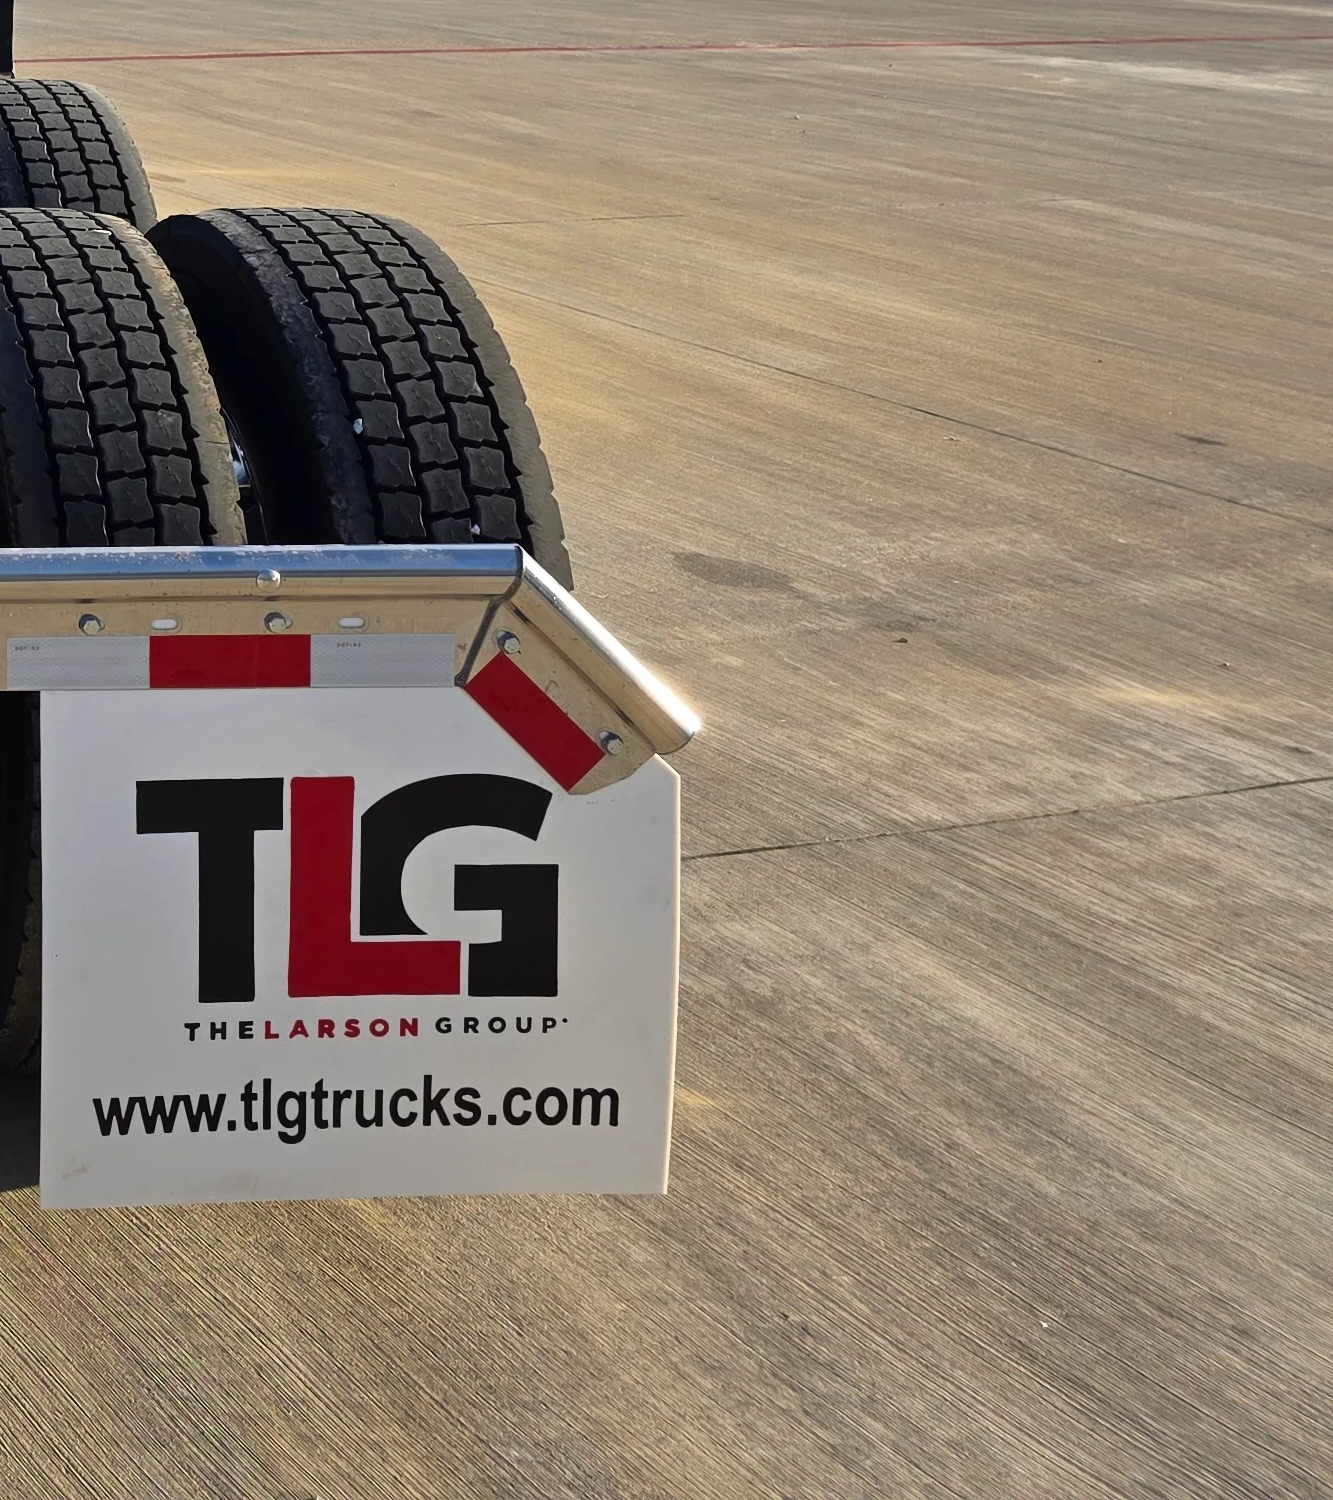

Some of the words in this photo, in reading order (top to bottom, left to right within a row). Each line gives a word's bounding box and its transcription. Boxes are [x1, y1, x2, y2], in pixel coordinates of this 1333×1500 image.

[135, 773, 560, 1004] TLG
[434, 1016, 557, 1034] GROUP
[92, 1074, 620, 1145] www.tlgtrucks.com
